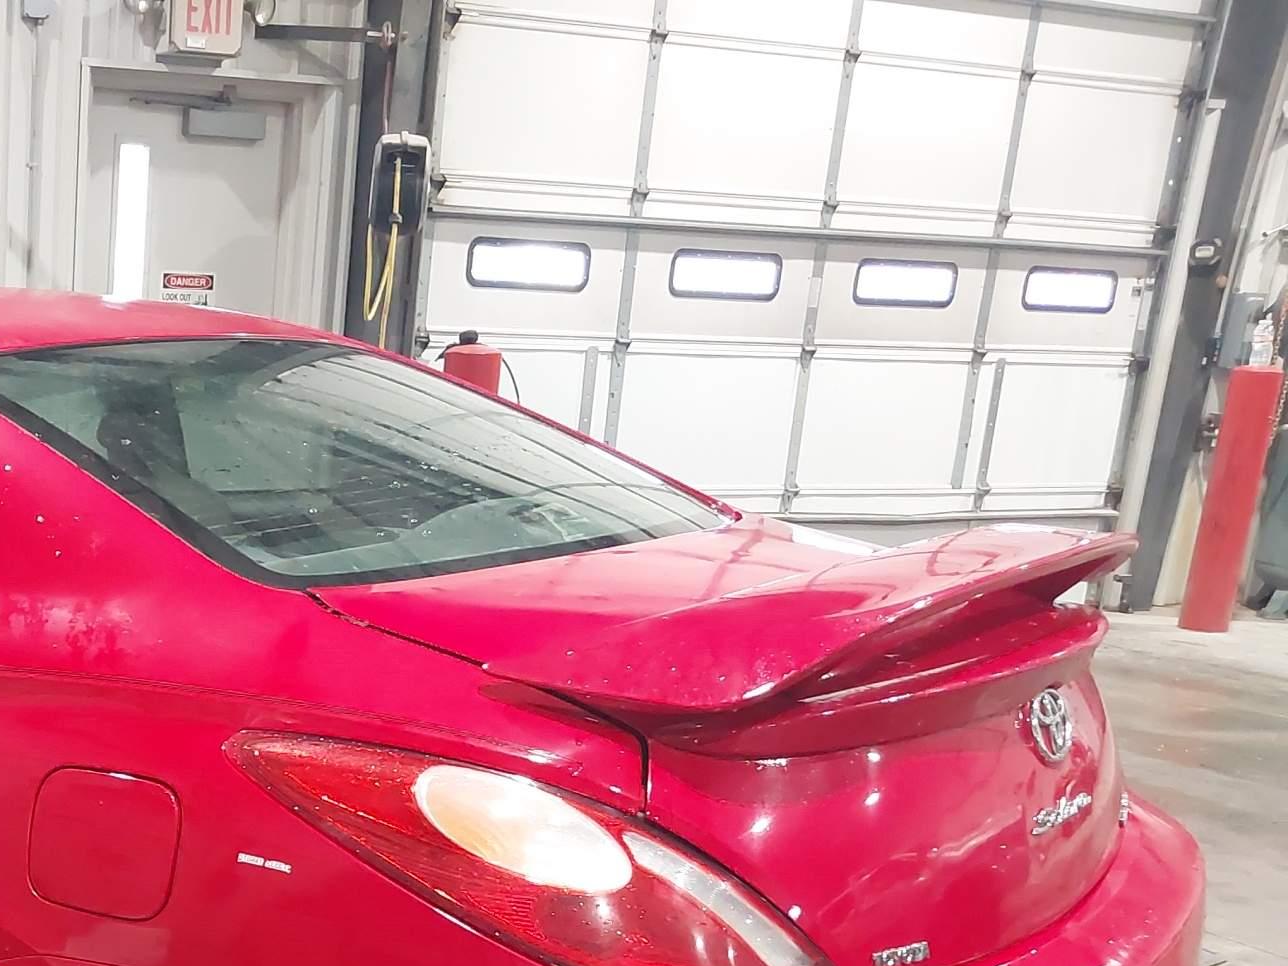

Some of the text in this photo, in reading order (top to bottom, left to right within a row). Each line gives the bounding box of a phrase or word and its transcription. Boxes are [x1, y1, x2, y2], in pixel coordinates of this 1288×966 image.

[170, 277, 206, 287] DANGER
[161, 293, 192, 301] LOOK OUT
